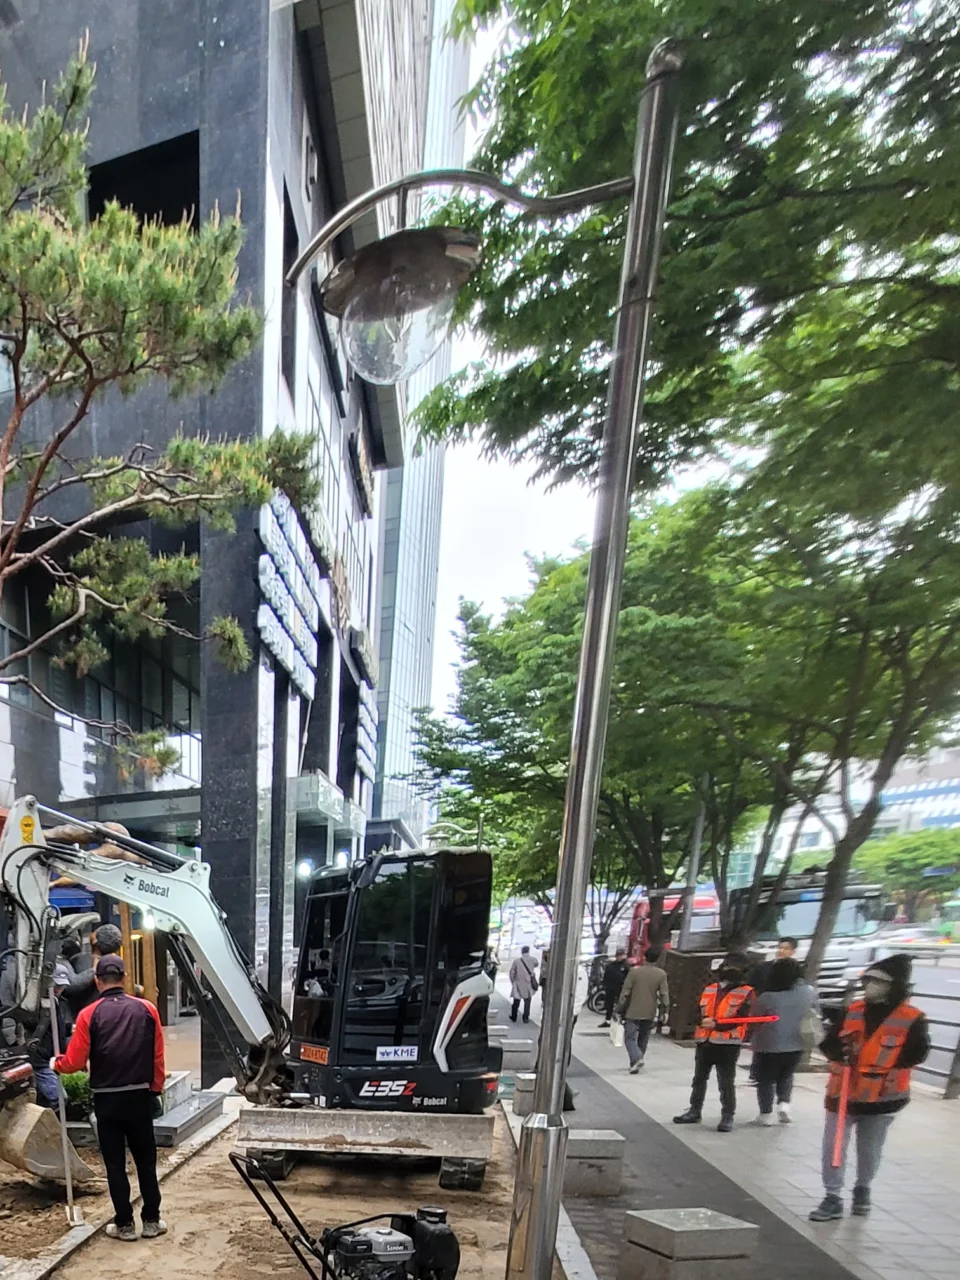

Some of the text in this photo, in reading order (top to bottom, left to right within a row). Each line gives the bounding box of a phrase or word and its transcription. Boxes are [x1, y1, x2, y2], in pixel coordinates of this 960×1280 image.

[138, 879, 170, 898] Bobcat
[393, 1048, 416, 1057] KME
[423, 1097, 447, 1107] Bobcat
